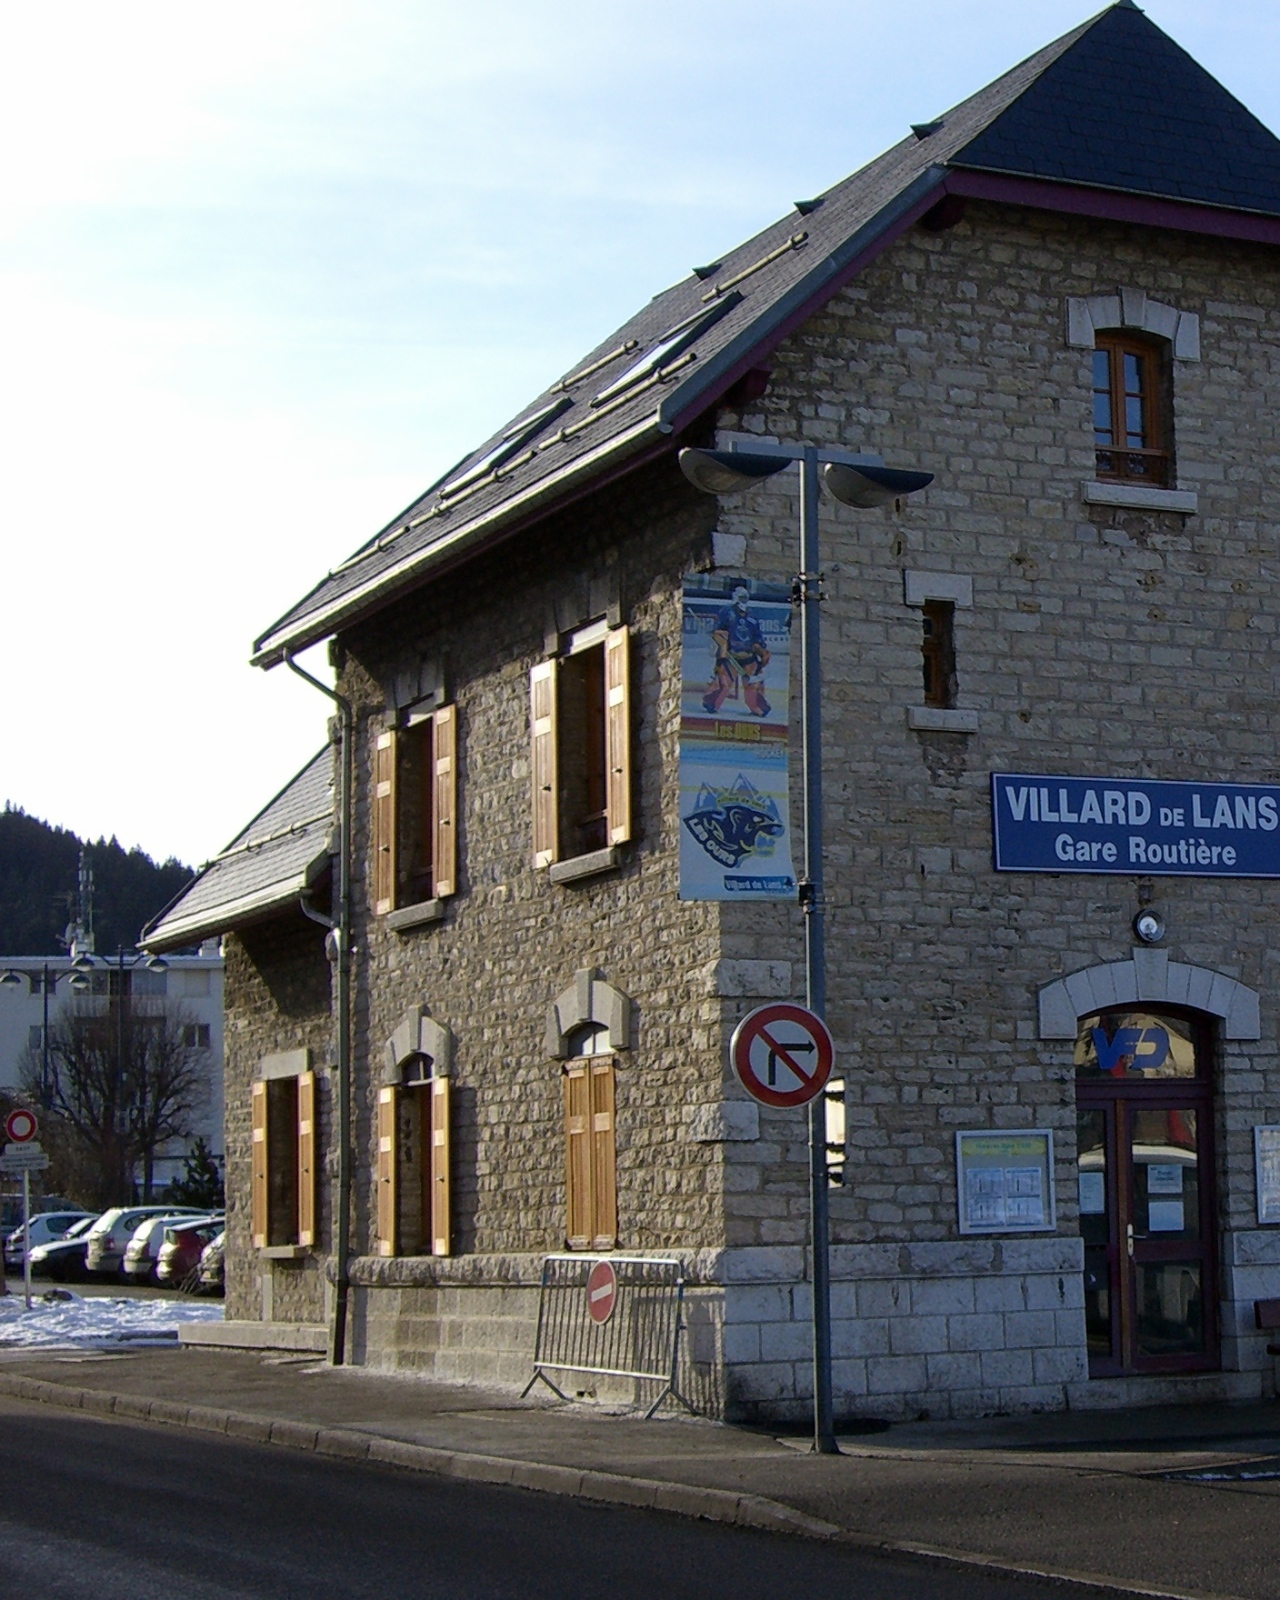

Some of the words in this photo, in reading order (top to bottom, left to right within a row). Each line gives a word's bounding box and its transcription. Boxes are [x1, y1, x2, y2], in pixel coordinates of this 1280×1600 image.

[1005, 786, 1152, 826] VILLARD
[1160, 807, 1185, 827] DE
[1192, 794, 1279, 831] LANS
[1055, 833, 1117, 862] Gare
[1129, 837, 1237, 866] Routière
